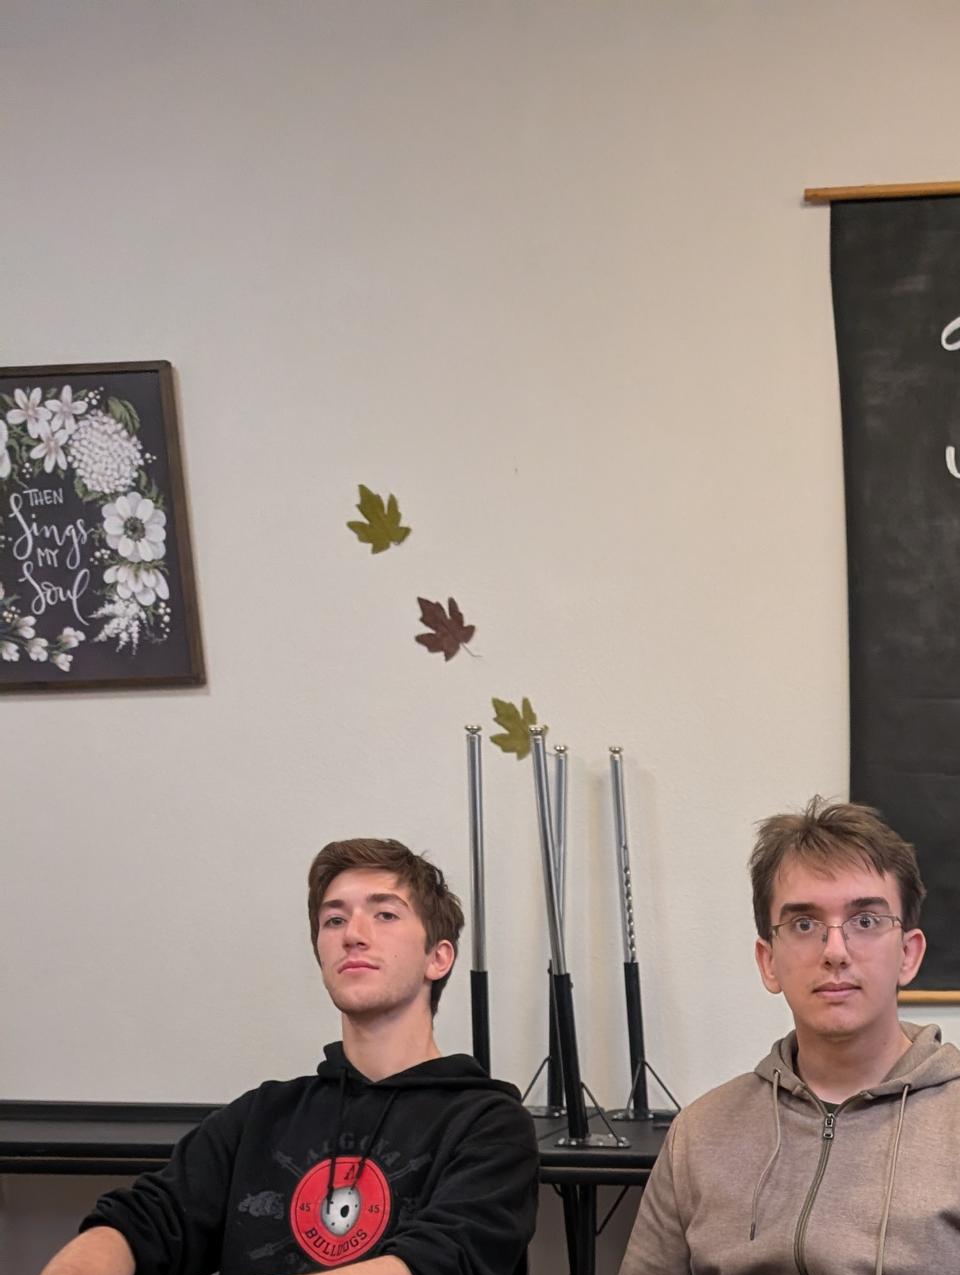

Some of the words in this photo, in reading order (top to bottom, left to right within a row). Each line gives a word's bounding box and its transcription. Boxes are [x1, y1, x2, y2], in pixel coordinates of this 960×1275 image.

[23, 488, 64, 506] THEN
[36, 547, 59, 567] MY
[300, 1202, 311, 1212] 45
[368, 1204, 380, 1214] 45
[304, 1227, 368, 1257] BULLDOGS
